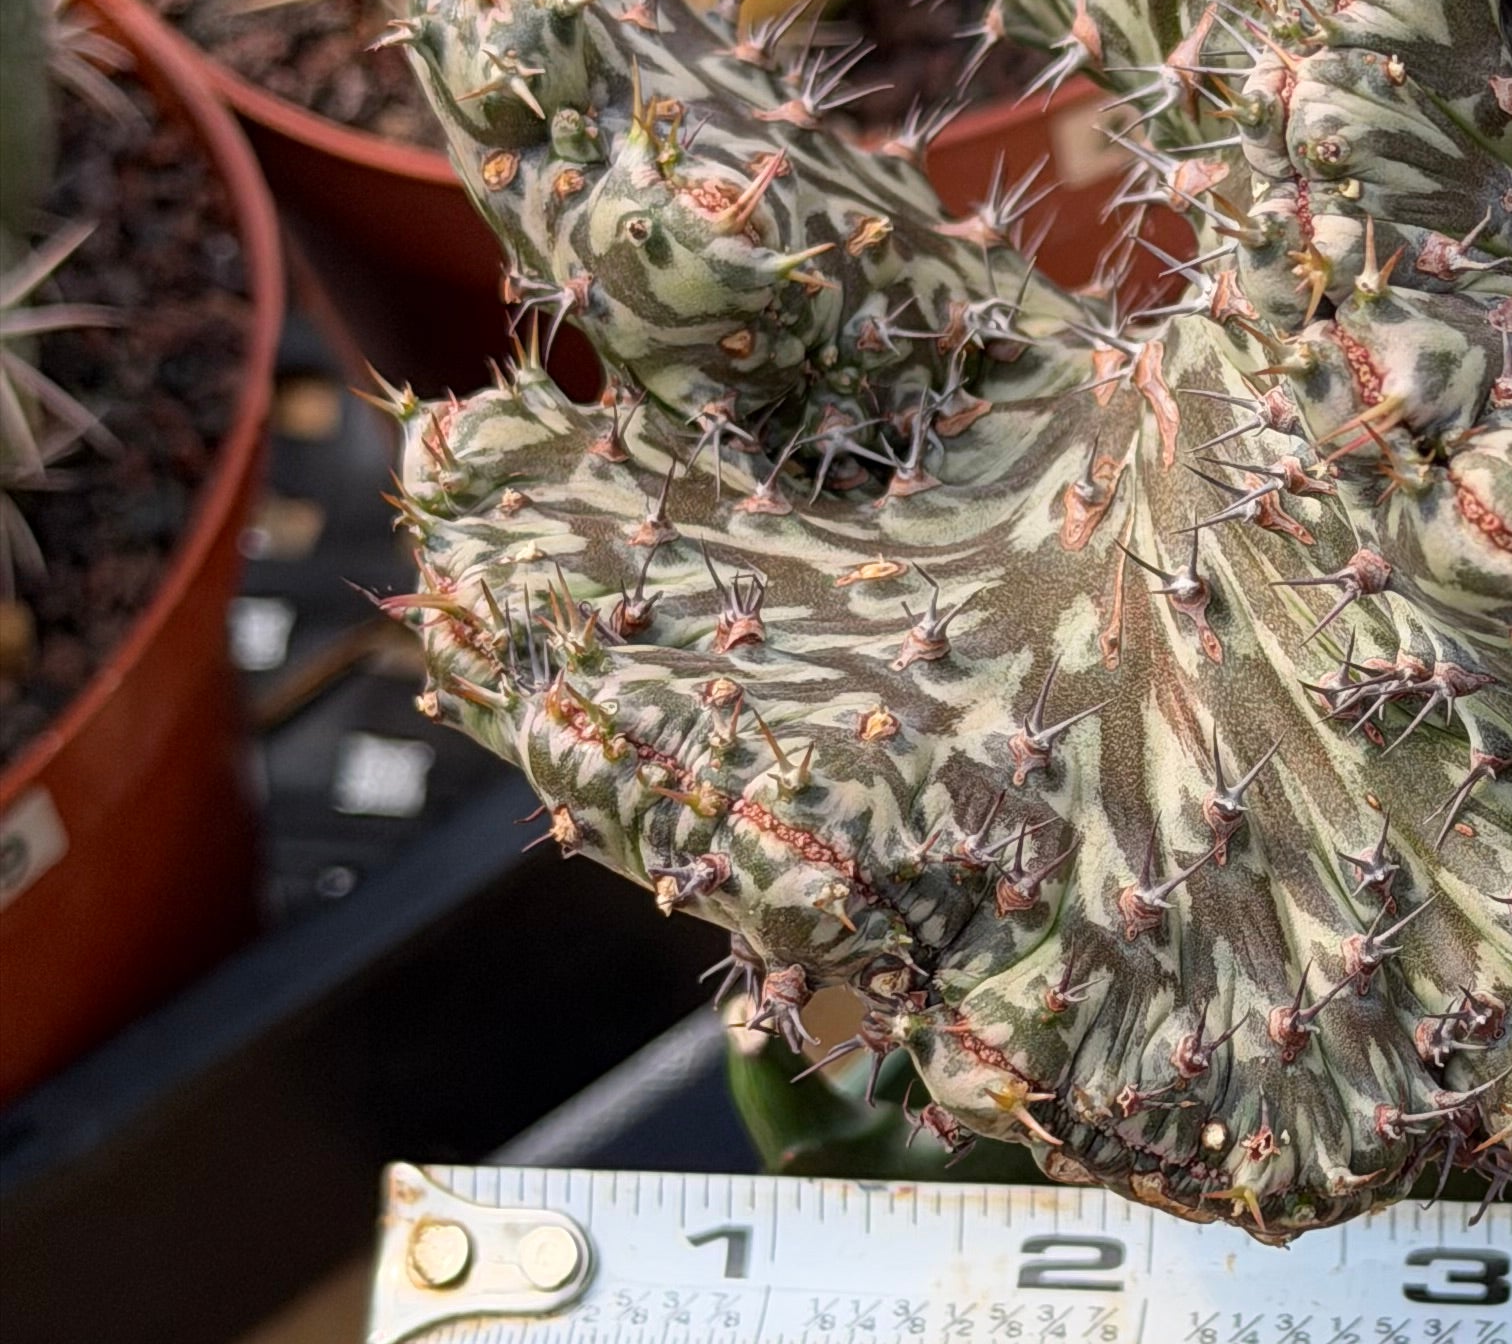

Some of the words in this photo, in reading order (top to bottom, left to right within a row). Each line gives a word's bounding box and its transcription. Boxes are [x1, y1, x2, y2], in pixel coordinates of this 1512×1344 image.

[685, 1225, 752, 1279] 1
[1017, 1233, 1126, 1292] 2
[1402, 1246, 1512, 1306] 3
